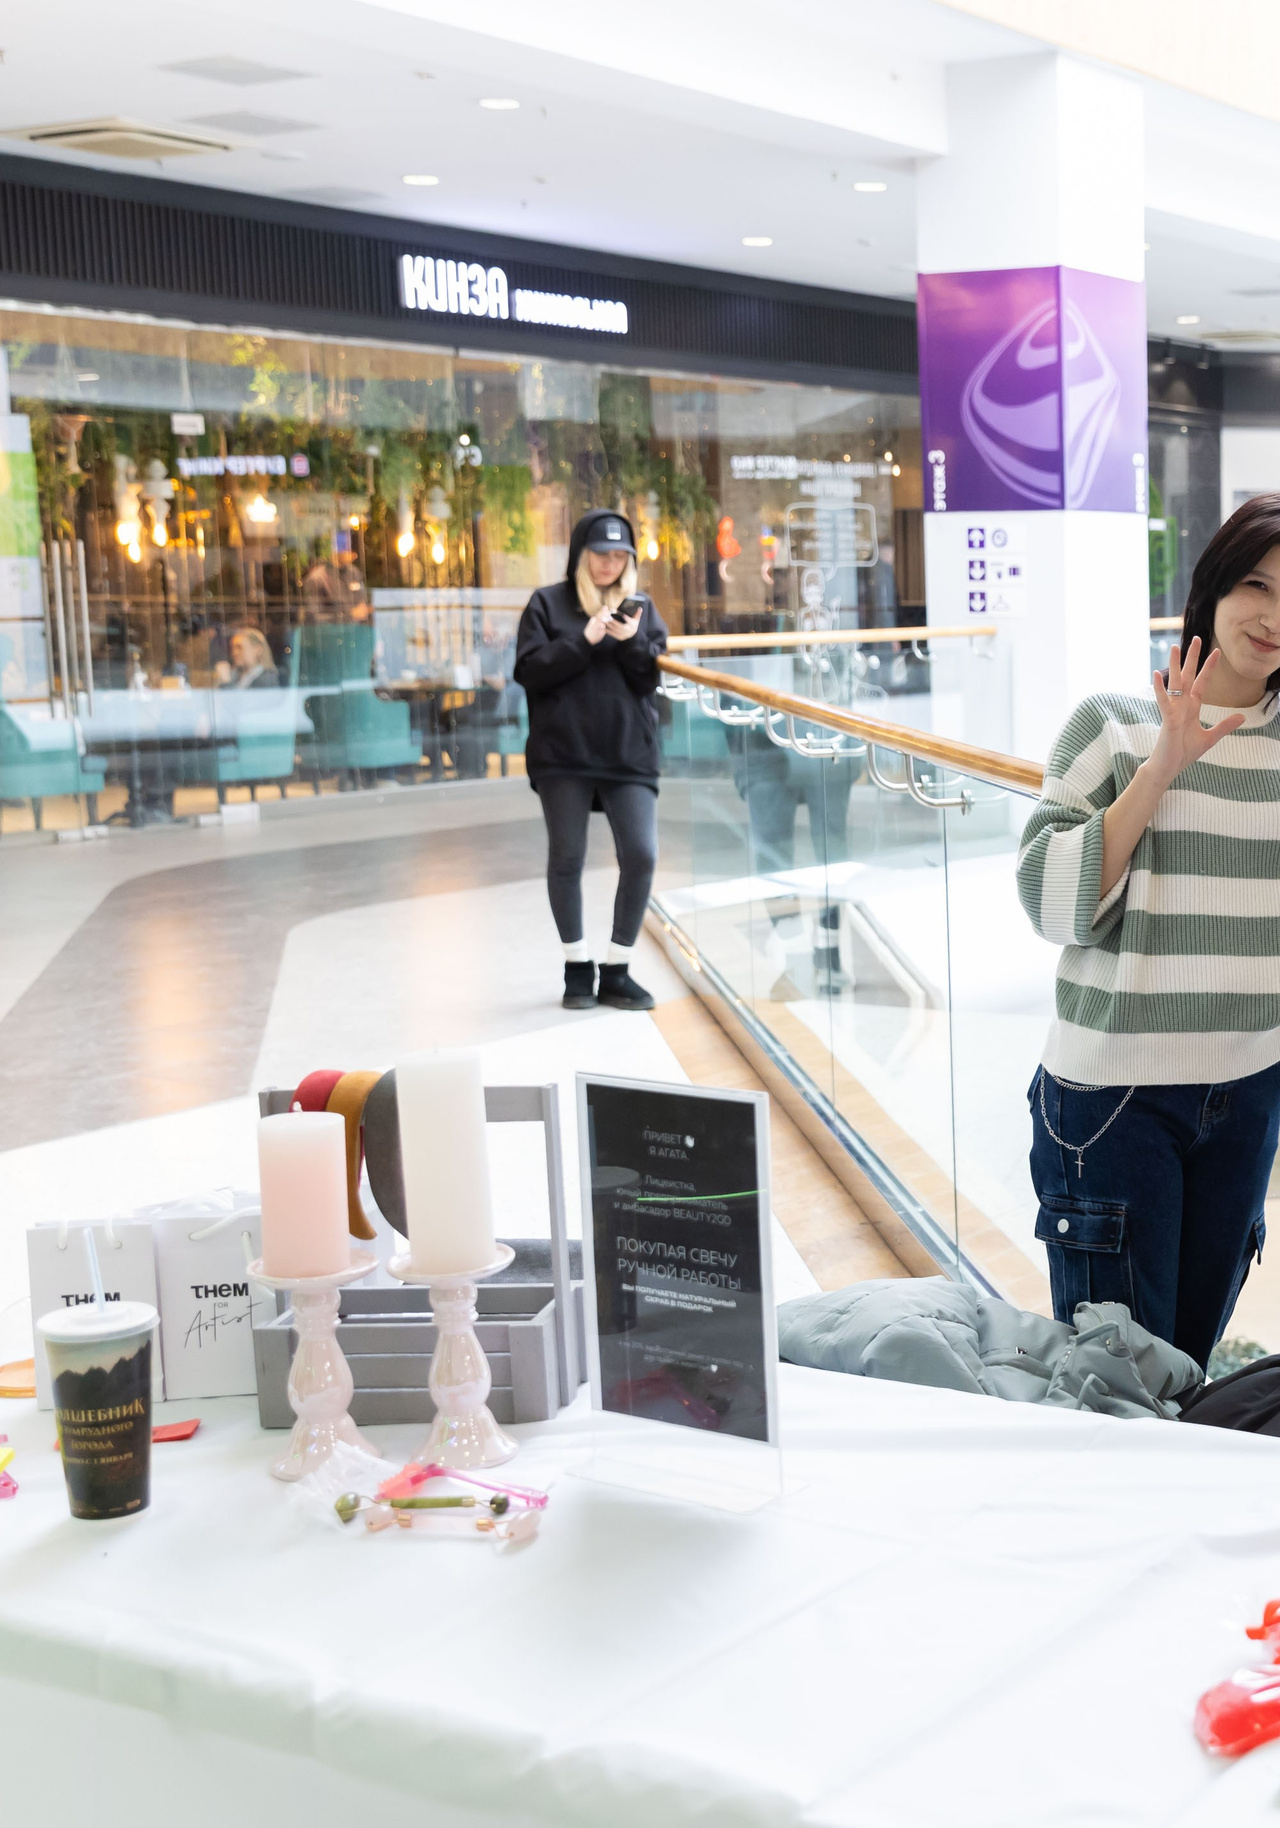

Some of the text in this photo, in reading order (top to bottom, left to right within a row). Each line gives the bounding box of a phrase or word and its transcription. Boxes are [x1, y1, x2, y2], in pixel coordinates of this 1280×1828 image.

[402, 253, 510, 320] КИНЗА
[928, 449, 945, 464] 3
[643, 1130, 683, 1145] ПРИВЕТ
[649, 1146, 657, 1157] Я
[616, 1187, 642, 1198] юный
[673, 1208, 732, 1227] BEAUTY2GO
[617, 1236, 738, 1268] ПОКУПАЯ СВЕЧУ
[618, 1257, 742, 1291] РУЧНОЙ РАБОТЫ
[622, 1283, 737, 1308] ВЫ ПОЛУЧАЕТЕ НАТУРАЛЬНЫЙ
[645, 1295, 714, 1313] СКРАБ В ПОДАРОК
[55, 1398, 145, 1423] ОЛШЕБНИК
